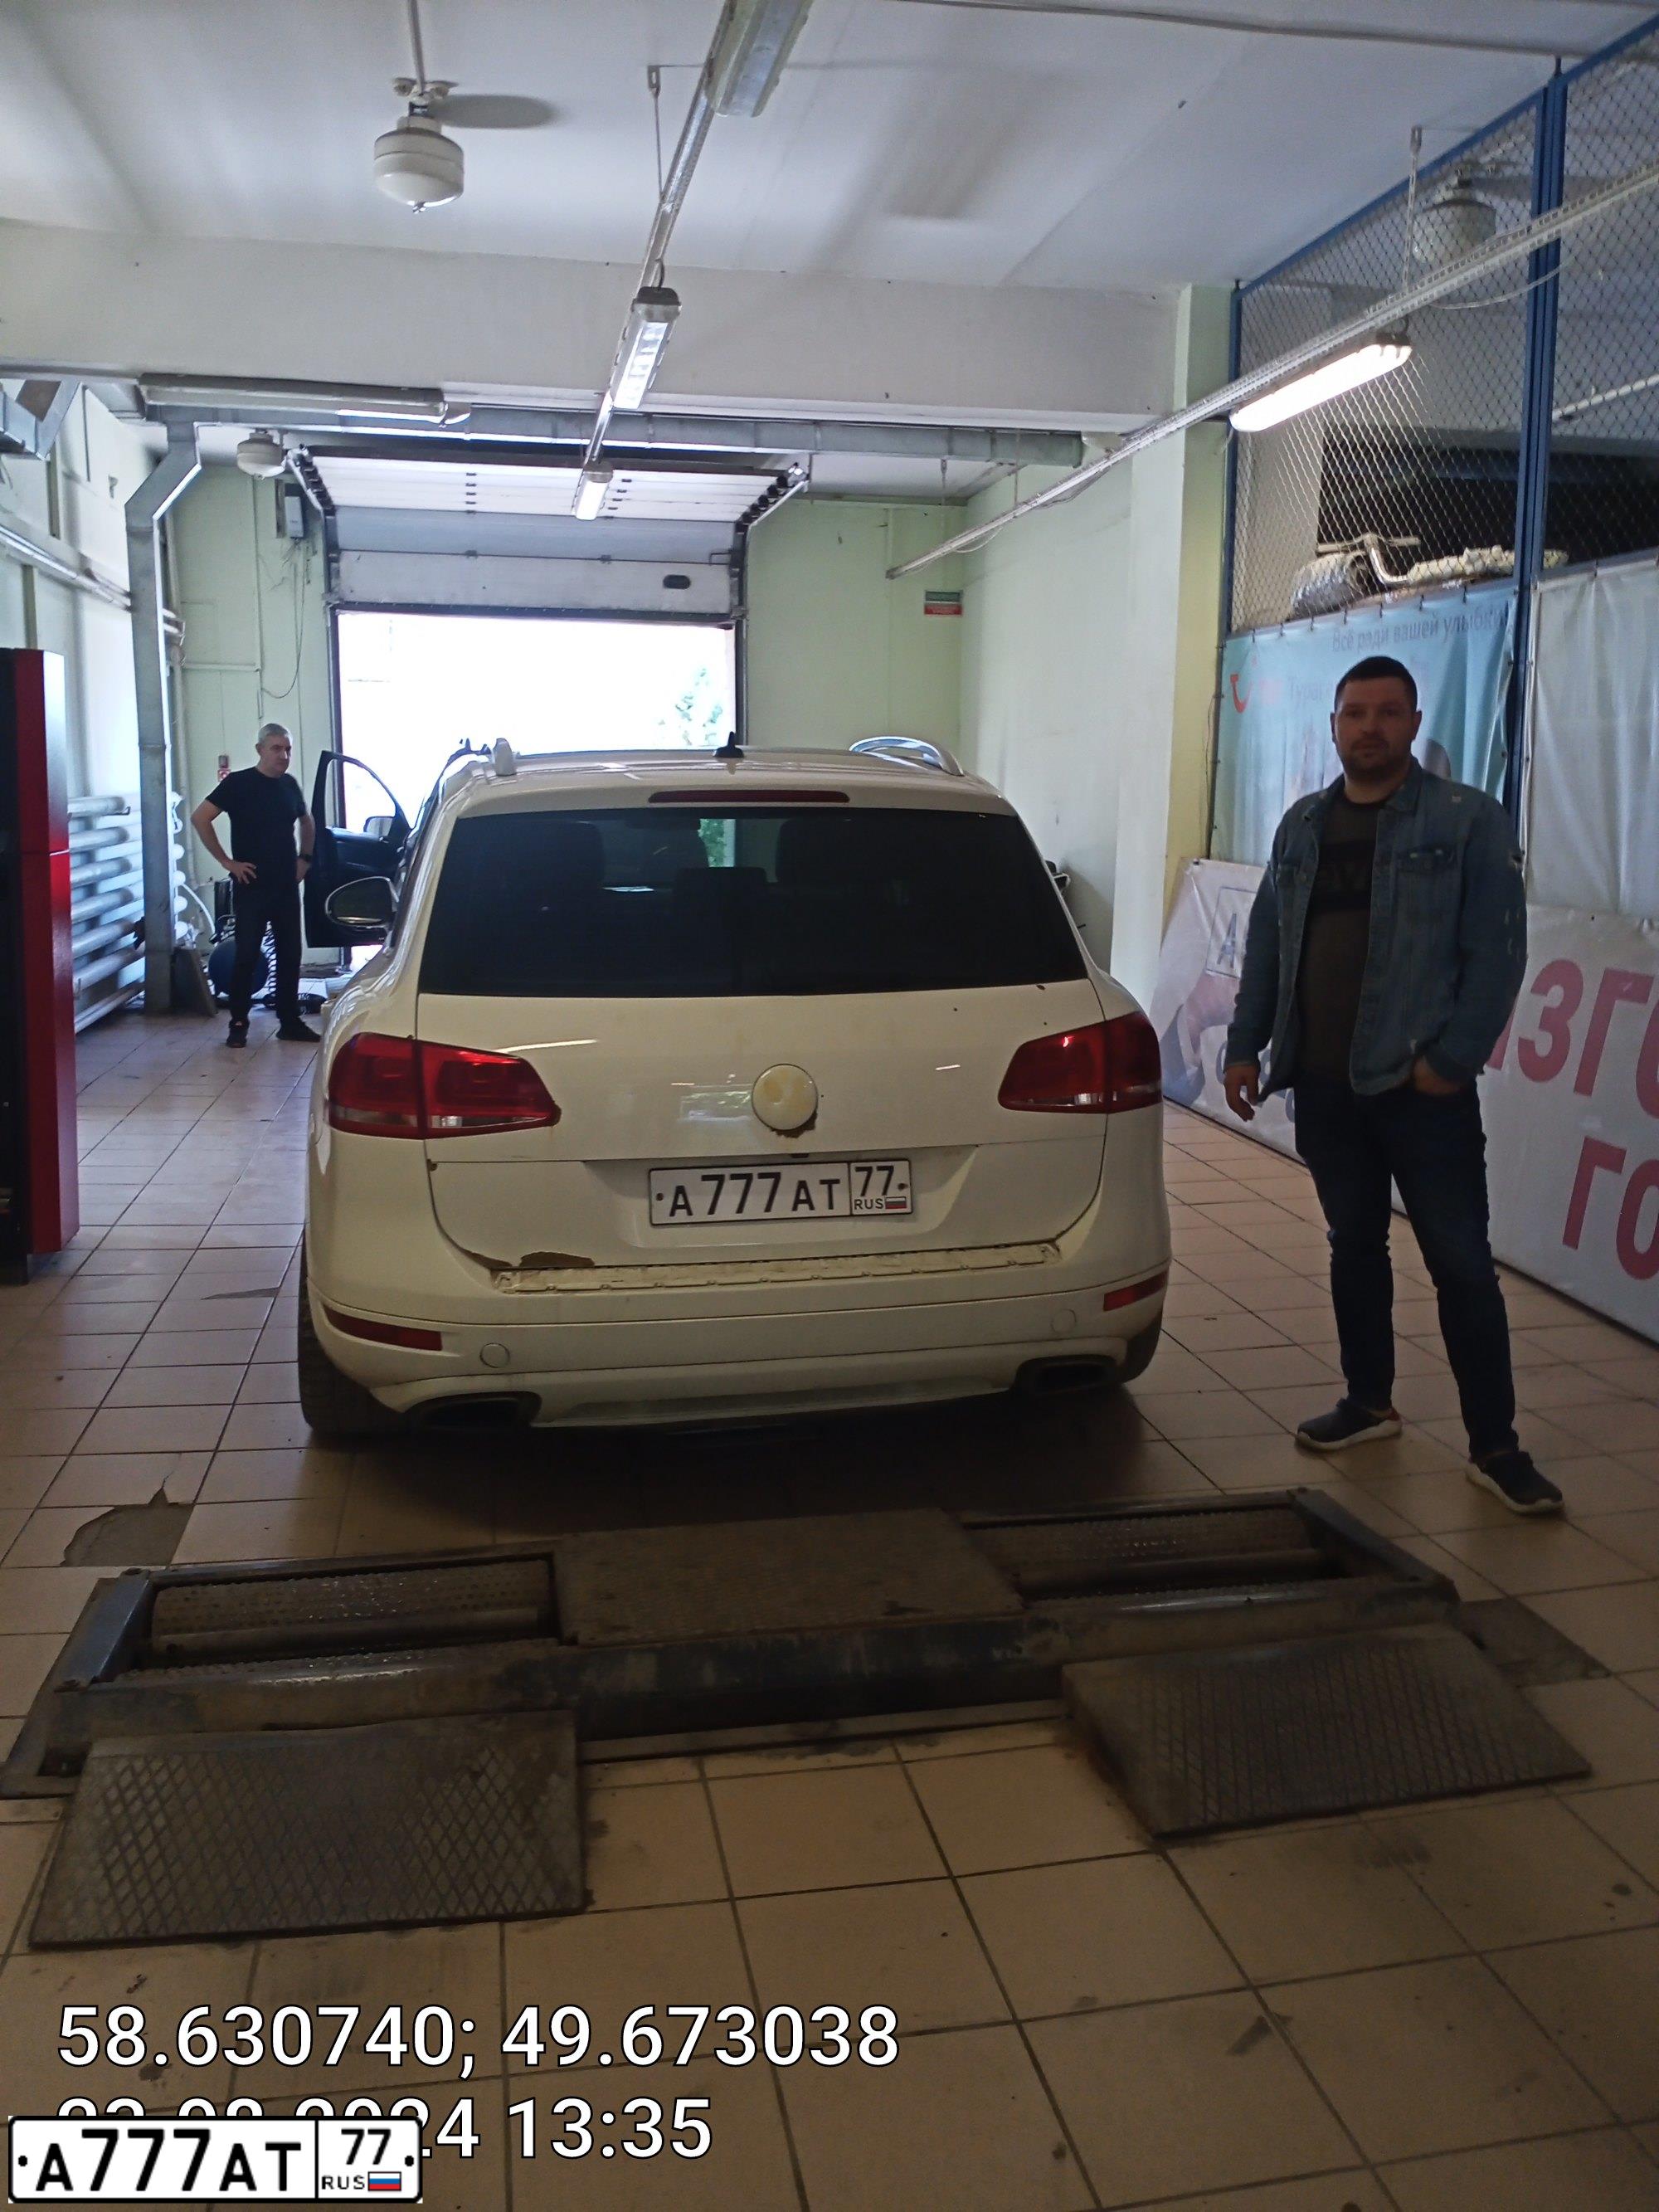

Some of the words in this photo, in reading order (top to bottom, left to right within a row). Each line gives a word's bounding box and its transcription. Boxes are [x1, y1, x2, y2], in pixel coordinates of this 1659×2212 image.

[1393, 612, 1438, 643] вашей
[854, 1165, 894, 1196] 77
[854, 1198, 884, 1210] RUS
